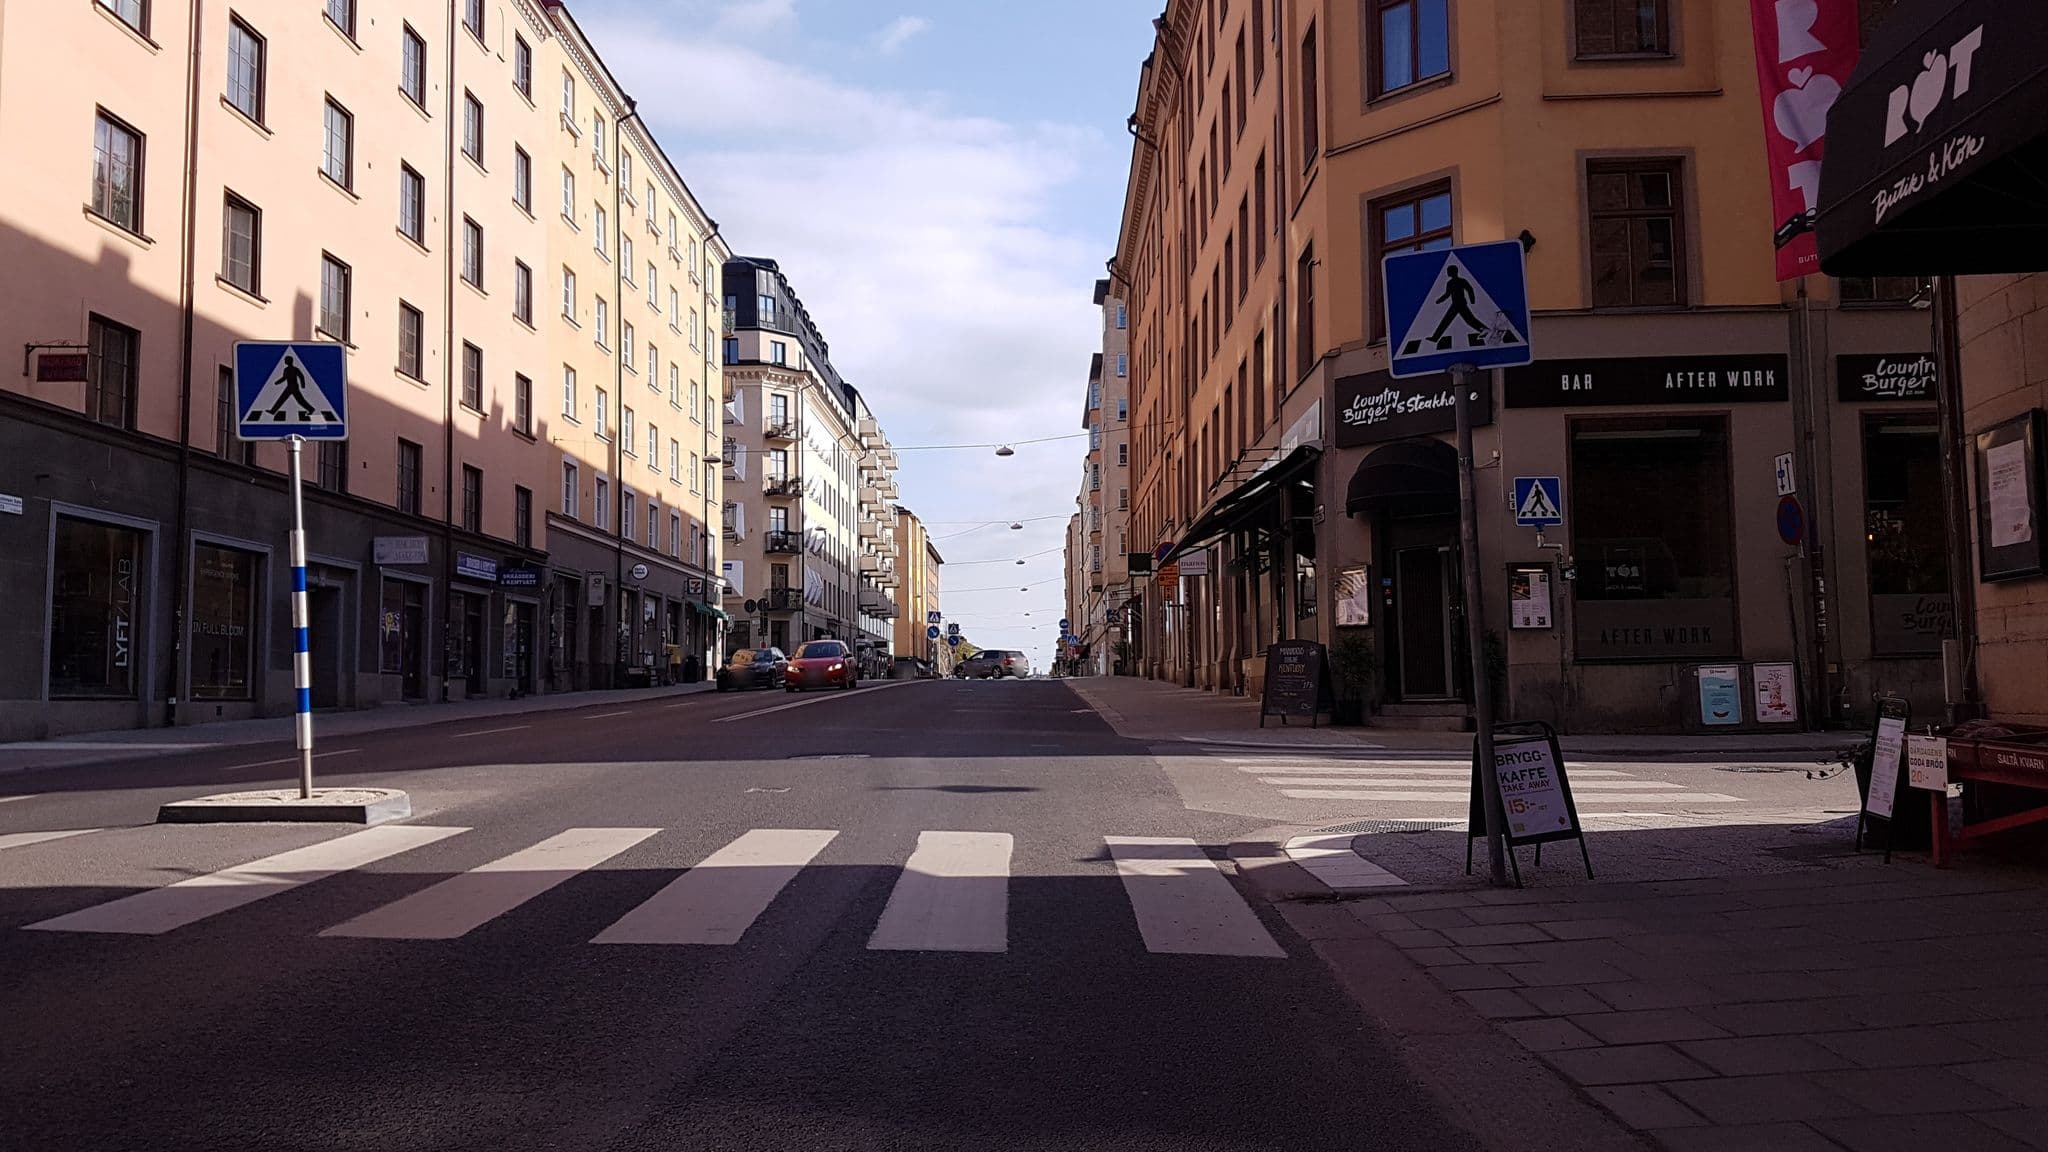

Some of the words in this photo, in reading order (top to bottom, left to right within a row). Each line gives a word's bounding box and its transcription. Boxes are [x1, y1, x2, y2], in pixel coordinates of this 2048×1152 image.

[1872, 172, 1925, 225] Butik
[1927, 152, 1940, 184] &
[1940, 134, 1985, 177] Kök
[1798, 254, 1818, 264] BUTI
[1561, 373, 1593, 391] BAR
[1665, 372, 1717, 389] AFTER
[1727, 369, 1776, 387] WORK
[1352, 387, 1400, 409] Country
[1406, 390, 1480, 414] Steakhoe
[1600, 628, 1652, 645] AFTER
[1663, 626, 1712, 645] WORK
[1495, 750, 1548, 767] BRYGG-
[2019, 757, 2046, 772] KVARN
[1499, 766, 1549, 784] KAFFE
[1502, 782, 1526, 793] TAKE
[1528, 779, 1551, 789] AWAY
